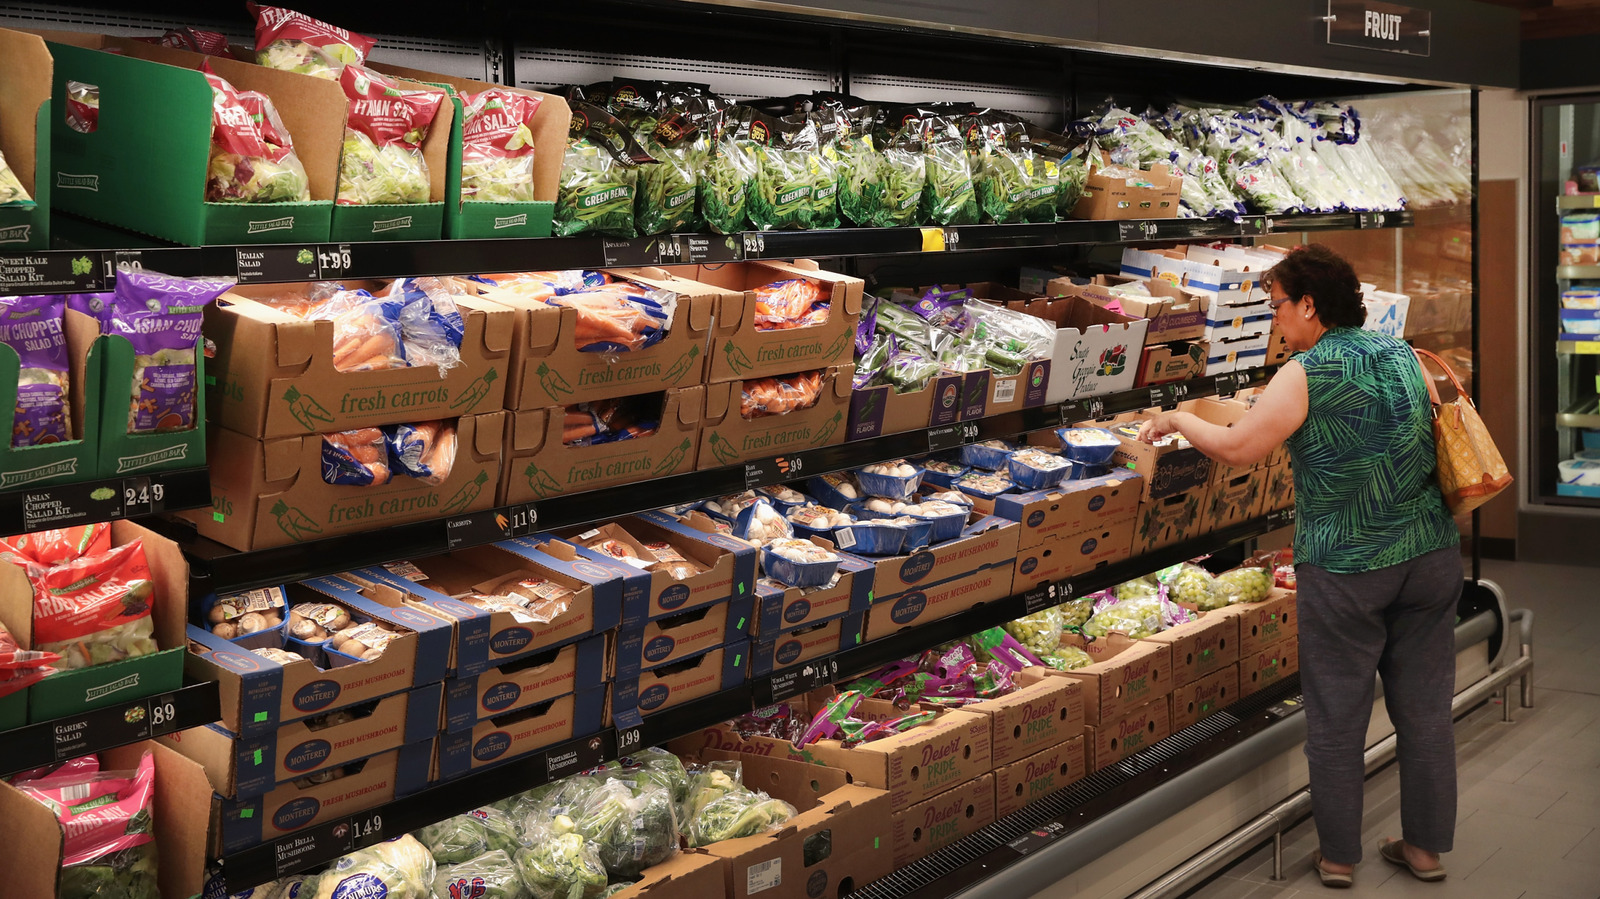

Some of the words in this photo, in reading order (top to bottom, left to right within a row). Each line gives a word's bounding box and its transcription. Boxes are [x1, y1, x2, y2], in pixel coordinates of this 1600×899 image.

[1364, 10, 1402, 41] FRUIT
[585, 193, 609, 207] GREEN
[610, 186, 628, 199] BEANS
[25, 257, 48, 266] KALE
[239, 259, 261, 268] SALAD
[29, 272, 44, 281] KIT
[25, 338, 52, 351] SALAD
[756, 345, 789, 362] fresh
[793, 341, 823, 358] carrots
[578, 365, 614, 386] fresh
[617, 361, 661, 381] carrots
[340, 392, 387, 413] fresh
[390, 385, 449, 408] carrots
[966, 408, 983, 416] FLAVOR
[741, 431, 775, 450] fresh
[778, 426, 811, 446] carrots
[856, 425, 876, 433] FLAVOR
[124, 458, 146, 468] LITTLE
[148, 453, 167, 464] SALAD
[169, 448, 182, 457] BAR
[6, 474, 31, 484] LITTLE
[33, 466, 55, 479] SALAD
[57, 463, 71, 473] BAR
[566, 461, 604, 485] fresh
[606, 456, 652, 478] carrots
[25, 494, 50, 503] ASIAN
[25, 501, 62, 511] CHOPPED
[26, 510, 53, 520] SALAD
[55, 507, 71, 516] KIT
[327, 502, 373, 524] fresh
[378, 494, 439, 517] carrots
[448, 518, 473, 529] CARROTS
[936, 552, 956, 566] FRESH
[958, 539, 999, 558] MUSHROOMS
[903, 561, 931, 577] MONTEREY
[661, 592, 688, 604] MONTEREY
[927, 592, 948, 606] FRESH
[950, 577, 992, 598] MUSHROOMS
[894, 602, 923, 618] MONTEREY
[493, 637, 528, 649] MONTEREY
[647, 645, 672, 657] MONTEREY
[343, 681, 363, 691] FRESH
[364, 668, 405, 686] MUSHROOMS
[1123, 660, 1150, 684] Desert
[522, 683, 540, 693] FRESH
[1127, 676, 1147, 694] PRIDE
[298, 690, 336, 705] MONTEREY
[486, 691, 517, 706] MONTEREY
[641, 694, 666, 707] MONTEREY
[1022, 698, 1057, 725] Desert
[56, 721, 88, 735] GARDEN
[513, 731, 531, 741] FRESH
[532, 719, 567, 736] MUSHROOMS
[1027, 715, 1053, 737] PRIDE
[1119, 714, 1147, 739] Desert
[56, 732, 82, 743] SALAD
[334, 739, 355, 750] FRESH
[356, 725, 398, 744] MUSHROOMS
[1123, 730, 1144, 750] PRIDE
[290, 750, 327, 766] MONTEREY
[476, 742, 508, 757] MONTEREY
[921, 736, 961, 768] Desert
[928, 757, 956, 780] PRIDE
[1025, 754, 1059, 783] Desert
[322, 795, 344, 807] FRESH
[345, 781, 387, 800] MUSHROOMS
[1029, 772, 1054, 796] PRIDE
[278, 807, 316, 824] MONTEREY
[924, 798, 964, 830] Desert
[353, 816, 383, 839] 1.49
[929, 818, 959, 840] PRIDE
[276, 840, 294, 853] BABY
[294, 835, 315, 848] BELLA
[277, 844, 316, 862] MUSHROOMS
